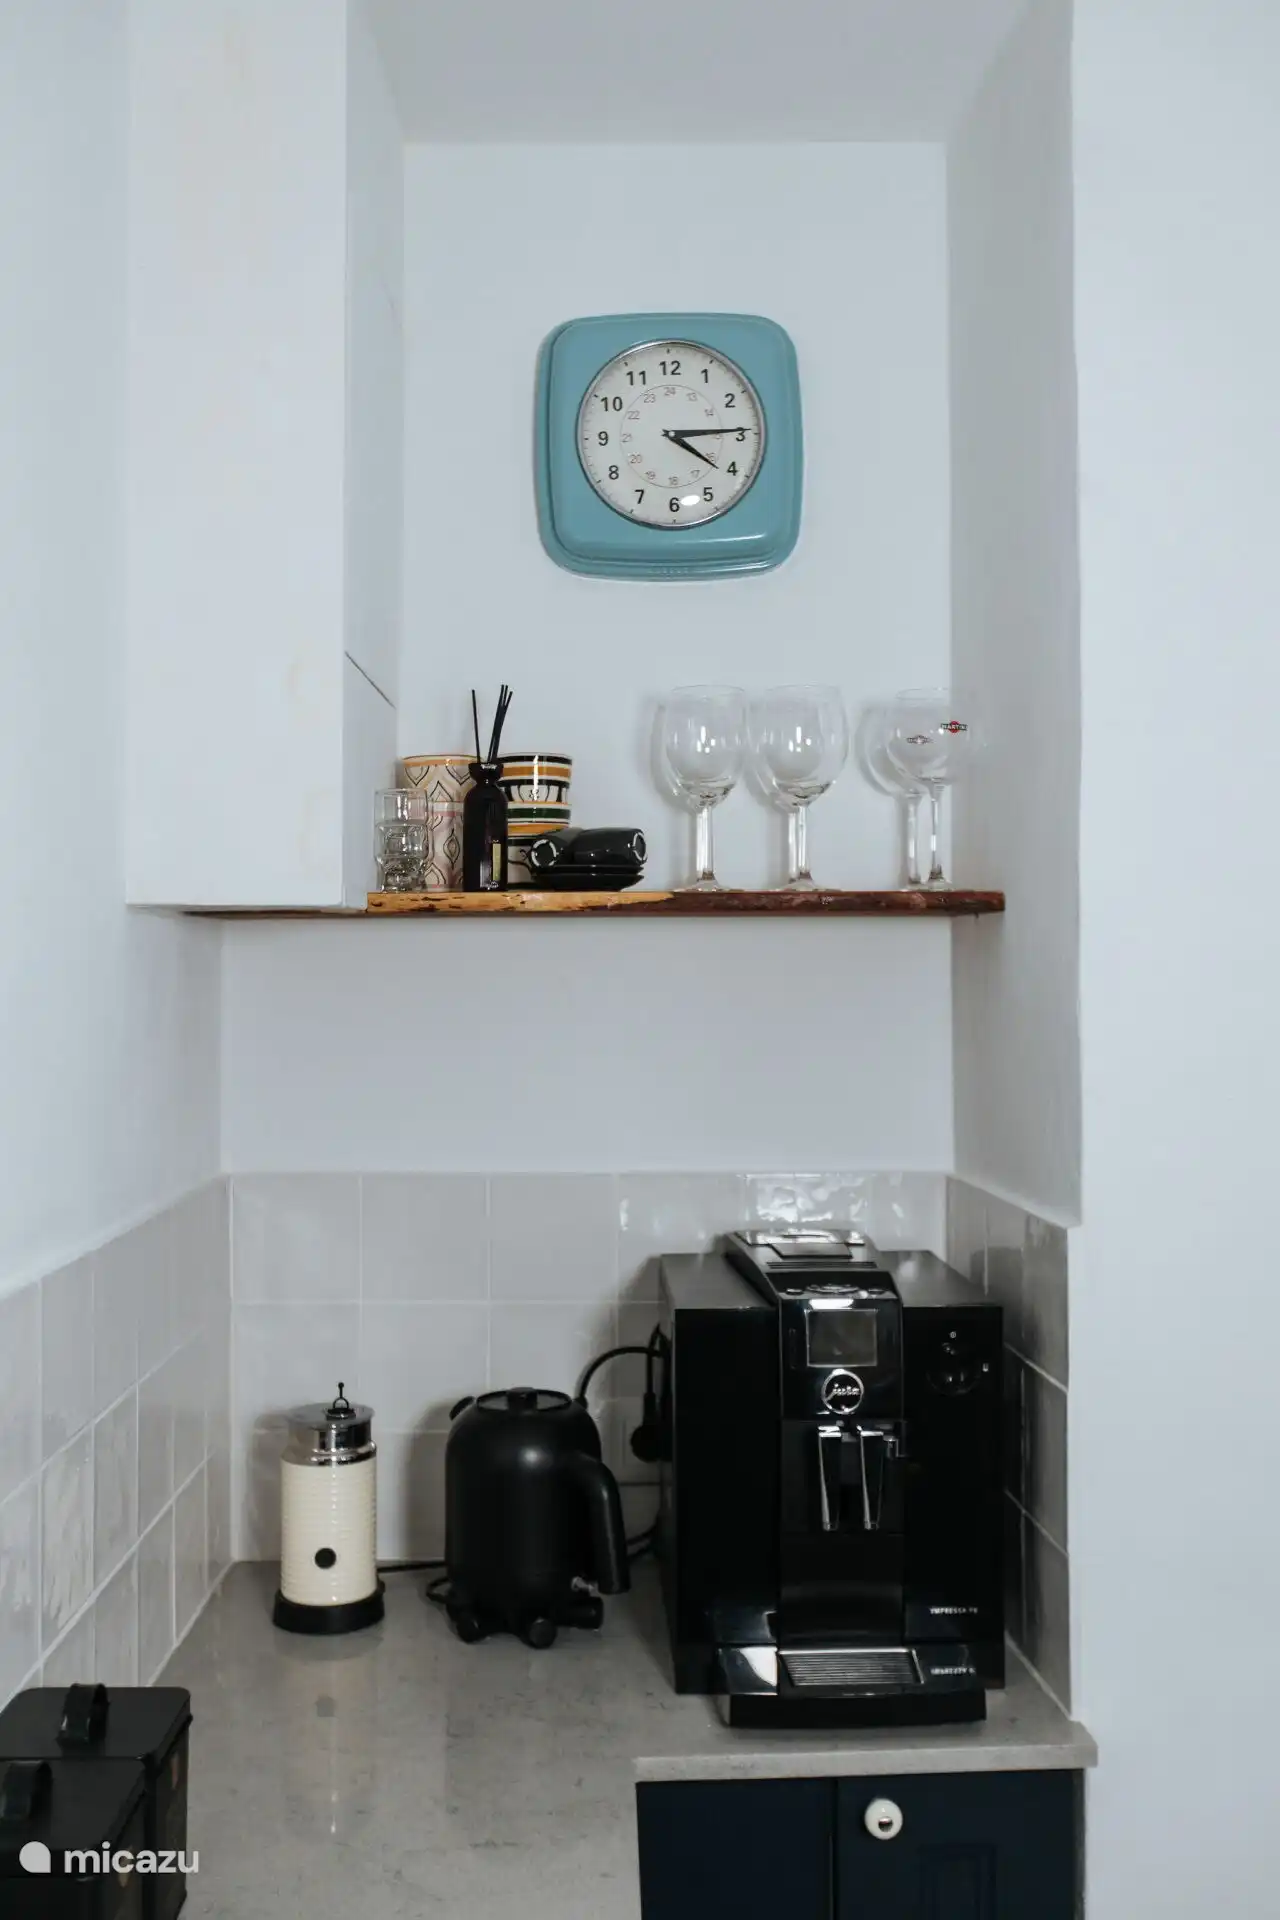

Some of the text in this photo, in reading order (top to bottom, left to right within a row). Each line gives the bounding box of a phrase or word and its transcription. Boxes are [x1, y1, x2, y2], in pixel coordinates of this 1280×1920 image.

[659, 361, 681, 376] 12
[626, 371, 647, 386] 11
[701, 369, 709, 384] 1
[601, 396, 623, 412] 10
[724, 393, 736, 409] 2
[627, 410, 640, 420] 22
[598, 431, 609, 446] 9
[735, 427, 746, 442] 3
[608, 465, 620, 480] 8
[726, 461, 738, 476] 4
[634, 489, 645, 504] 7
[702, 486, 714, 502] 5
[669, 497, 680, 513] 6
